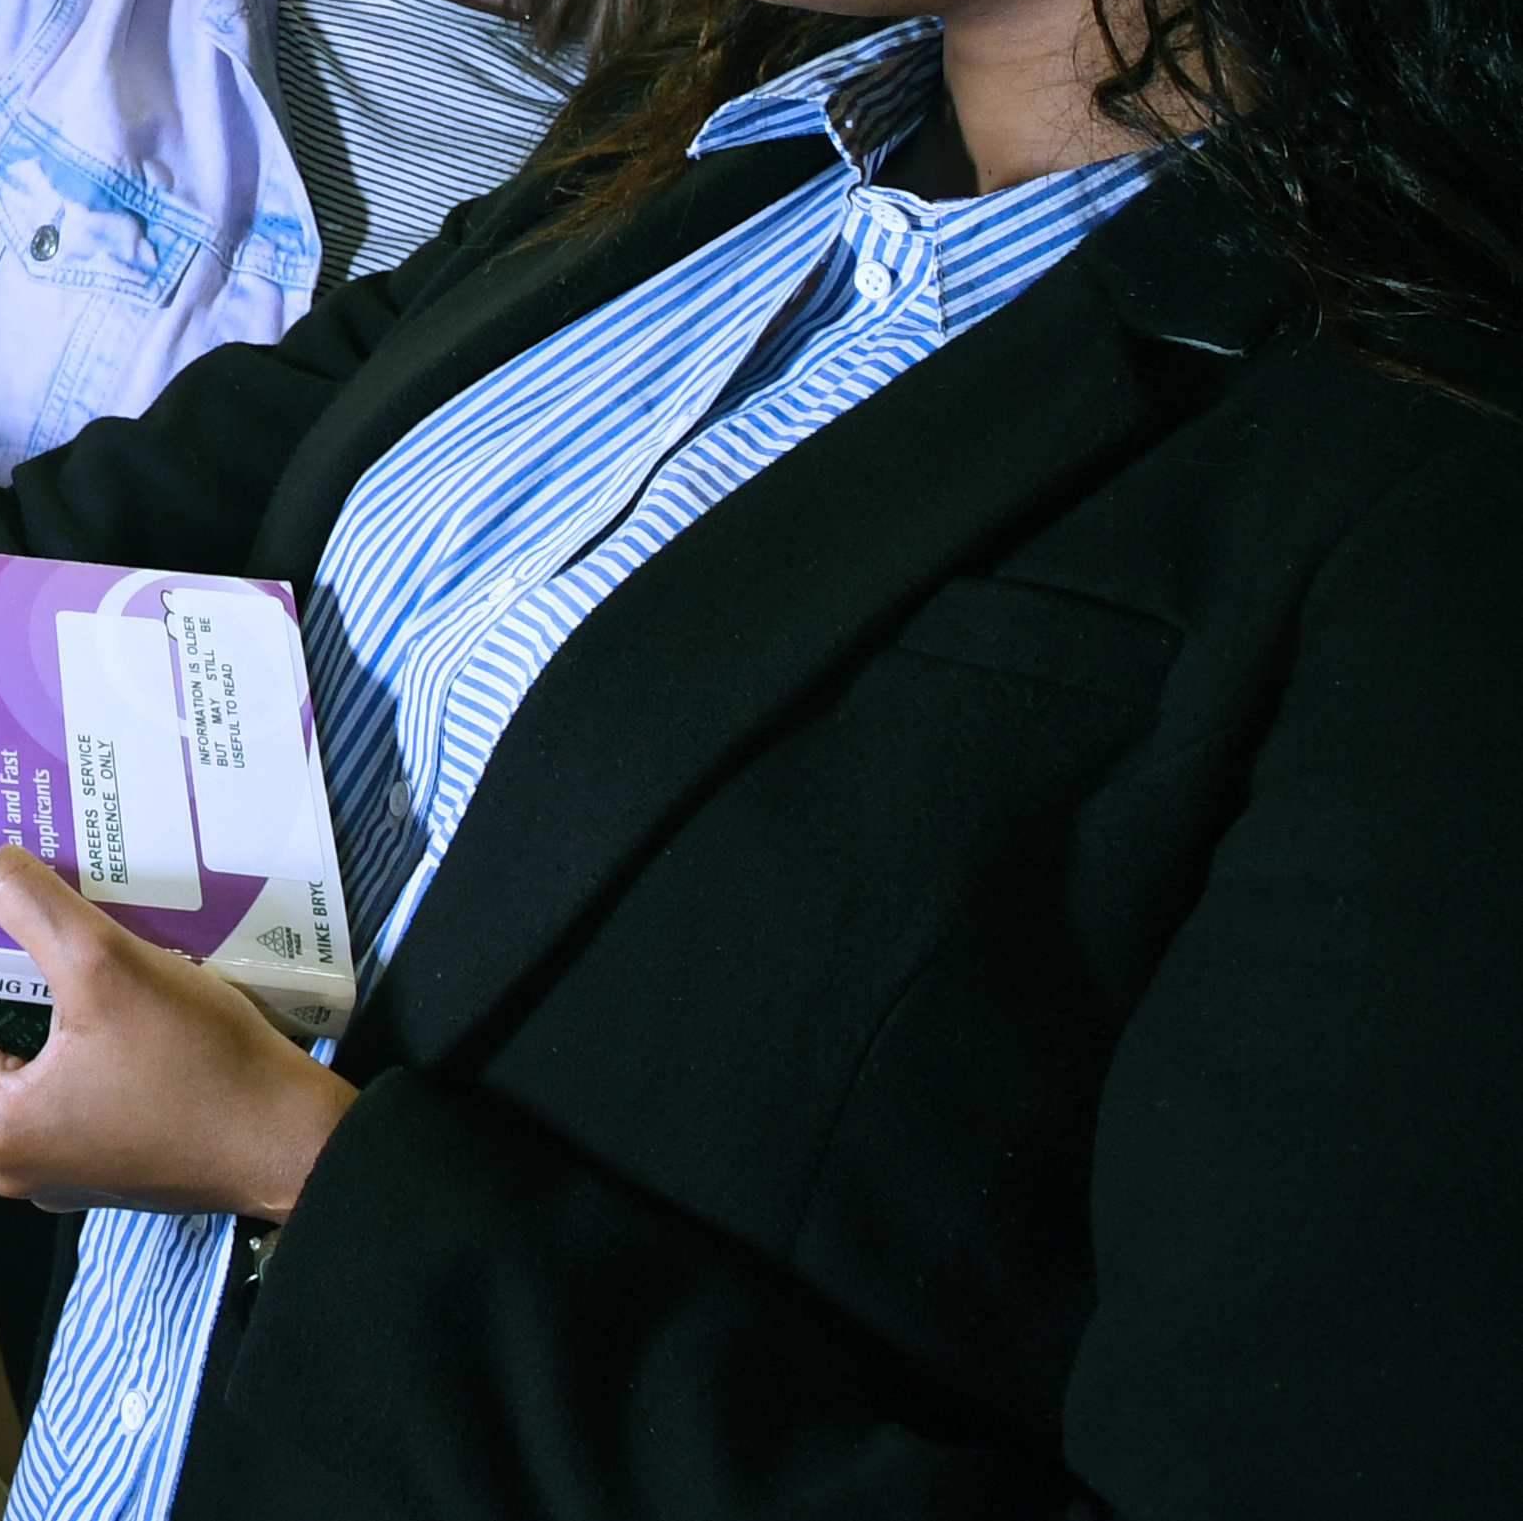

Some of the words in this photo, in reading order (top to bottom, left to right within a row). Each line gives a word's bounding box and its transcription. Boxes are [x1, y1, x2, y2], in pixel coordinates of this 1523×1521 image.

[183, 615, 198, 656] OLDER
[199, 616, 212, 633] BE
[189, 663, 200, 674] IS
[204, 649, 218, 681] STILL
[221, 663, 235, 697] READ
[191, 680, 212, 766] INFORMATION
[209, 698, 223, 725] MAY
[225, 699, 238, 716] TO
[98, 740, 113, 780] ONLY
[214, 741, 228, 767] BUT
[230, 720, 246, 769] USEFUL
[0, 749, 19, 785] Fast
[78, 734, 96, 796] SERVICE
[0, 790, 22, 825] and
[32, 768, 60, 859] applicants
[85, 808, 105, 882] CAREERS
[102, 792, 125, 884] REFERENCE
